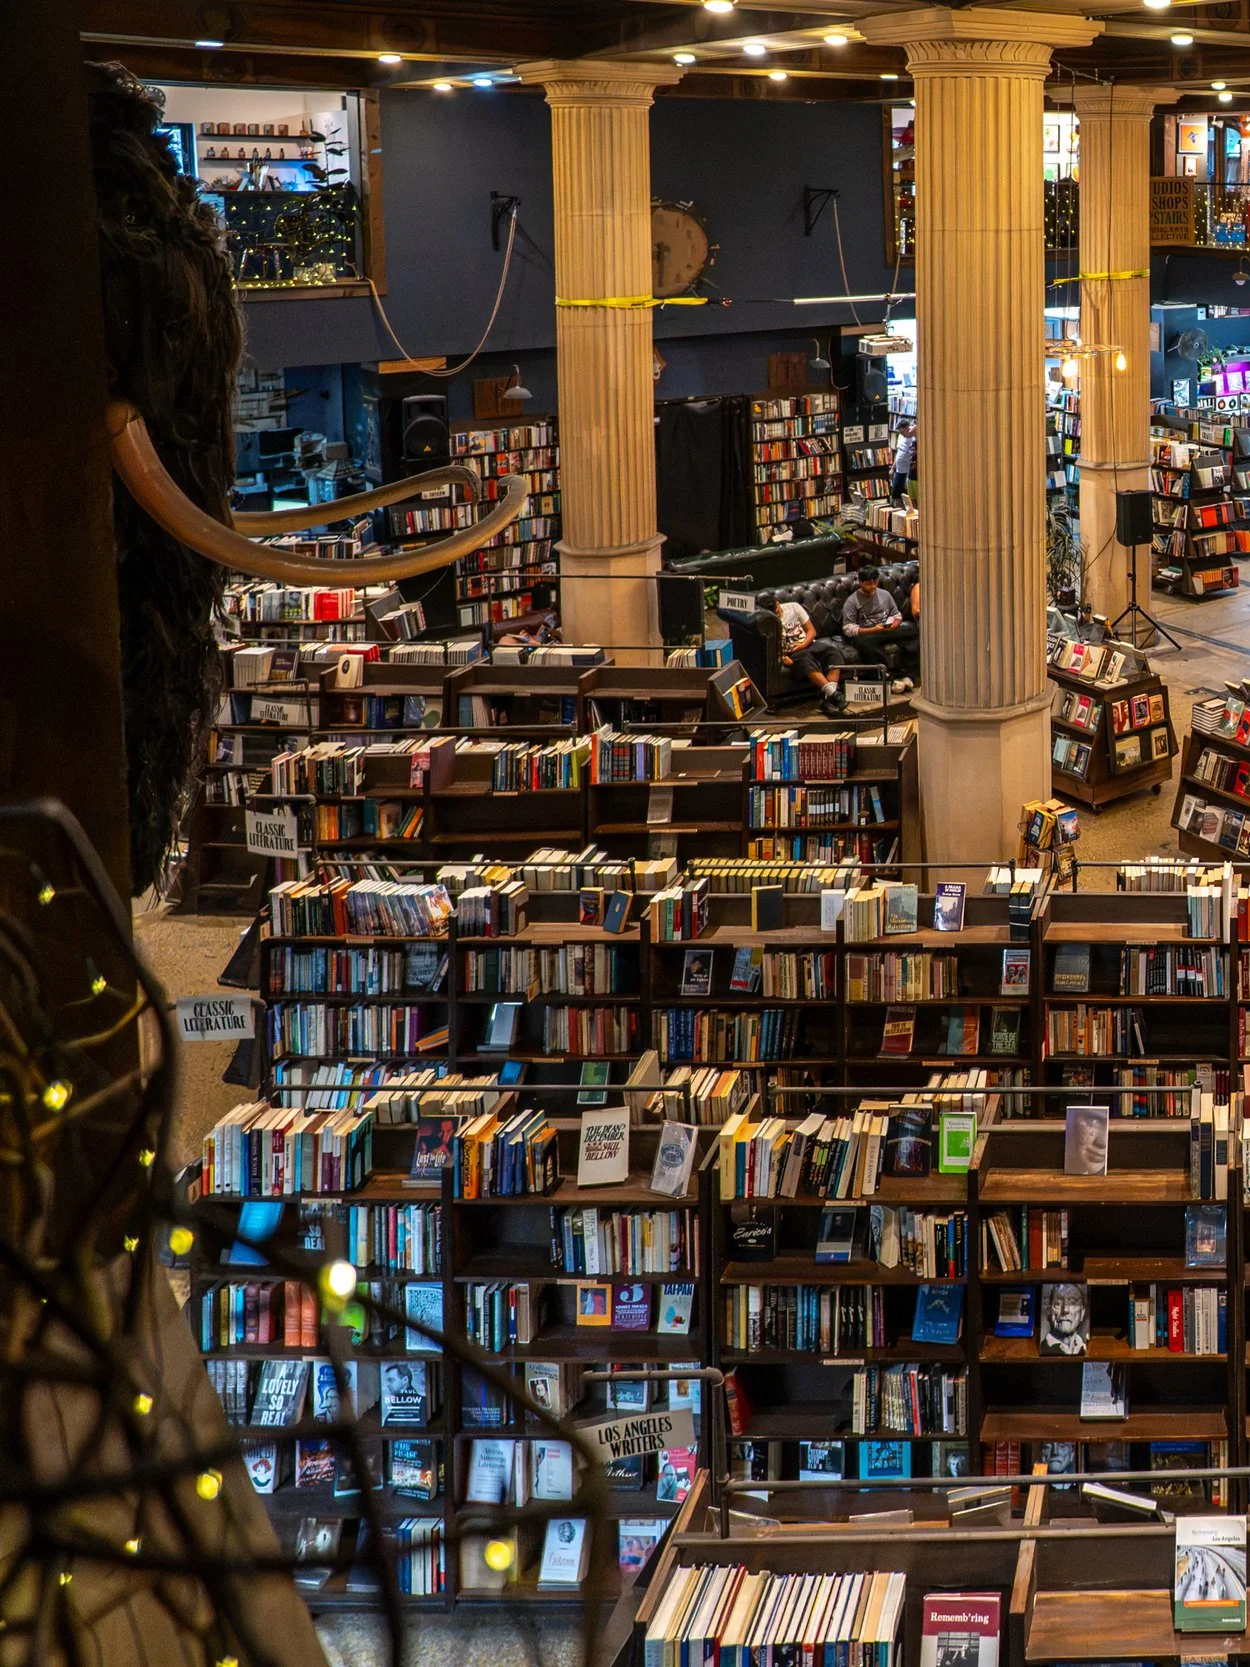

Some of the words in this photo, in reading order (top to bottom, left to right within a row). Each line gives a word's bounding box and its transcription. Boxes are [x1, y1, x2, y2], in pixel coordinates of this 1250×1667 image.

[1153, 182, 1188, 194] UDIOS
[727, 597, 749, 608] POETRY
[256, 821, 286, 837] CLASSIC
[250, 832, 295, 851] LITERATURE
[194, 1000, 235, 1018] CLASSIC
[184, 1015, 248, 1032] LITERATURE
[584, 1132, 624, 1143] DECEMBER
[586, 1126, 600, 1136] THE
[603, 1141, 620, 1151] SAUL
[585, 1151, 619, 1160] BELLOW
[1171, 1306, 1180, 1320] Night
[280, 1364, 287, 1379] A
[262, 1379, 299, 1395] LOVELY
[268, 1395, 285, 1411] SO
[384, 1396, 422, 1404] BELLOW
[260, 1411, 286, 1426] REAL
[598, 1425, 620, 1444] LOS
[624, 1416, 673, 1440] ANGELES
[610, 1433, 664, 1459] WRITERS
[930, 1611, 989, 1625] Rememb'ring
